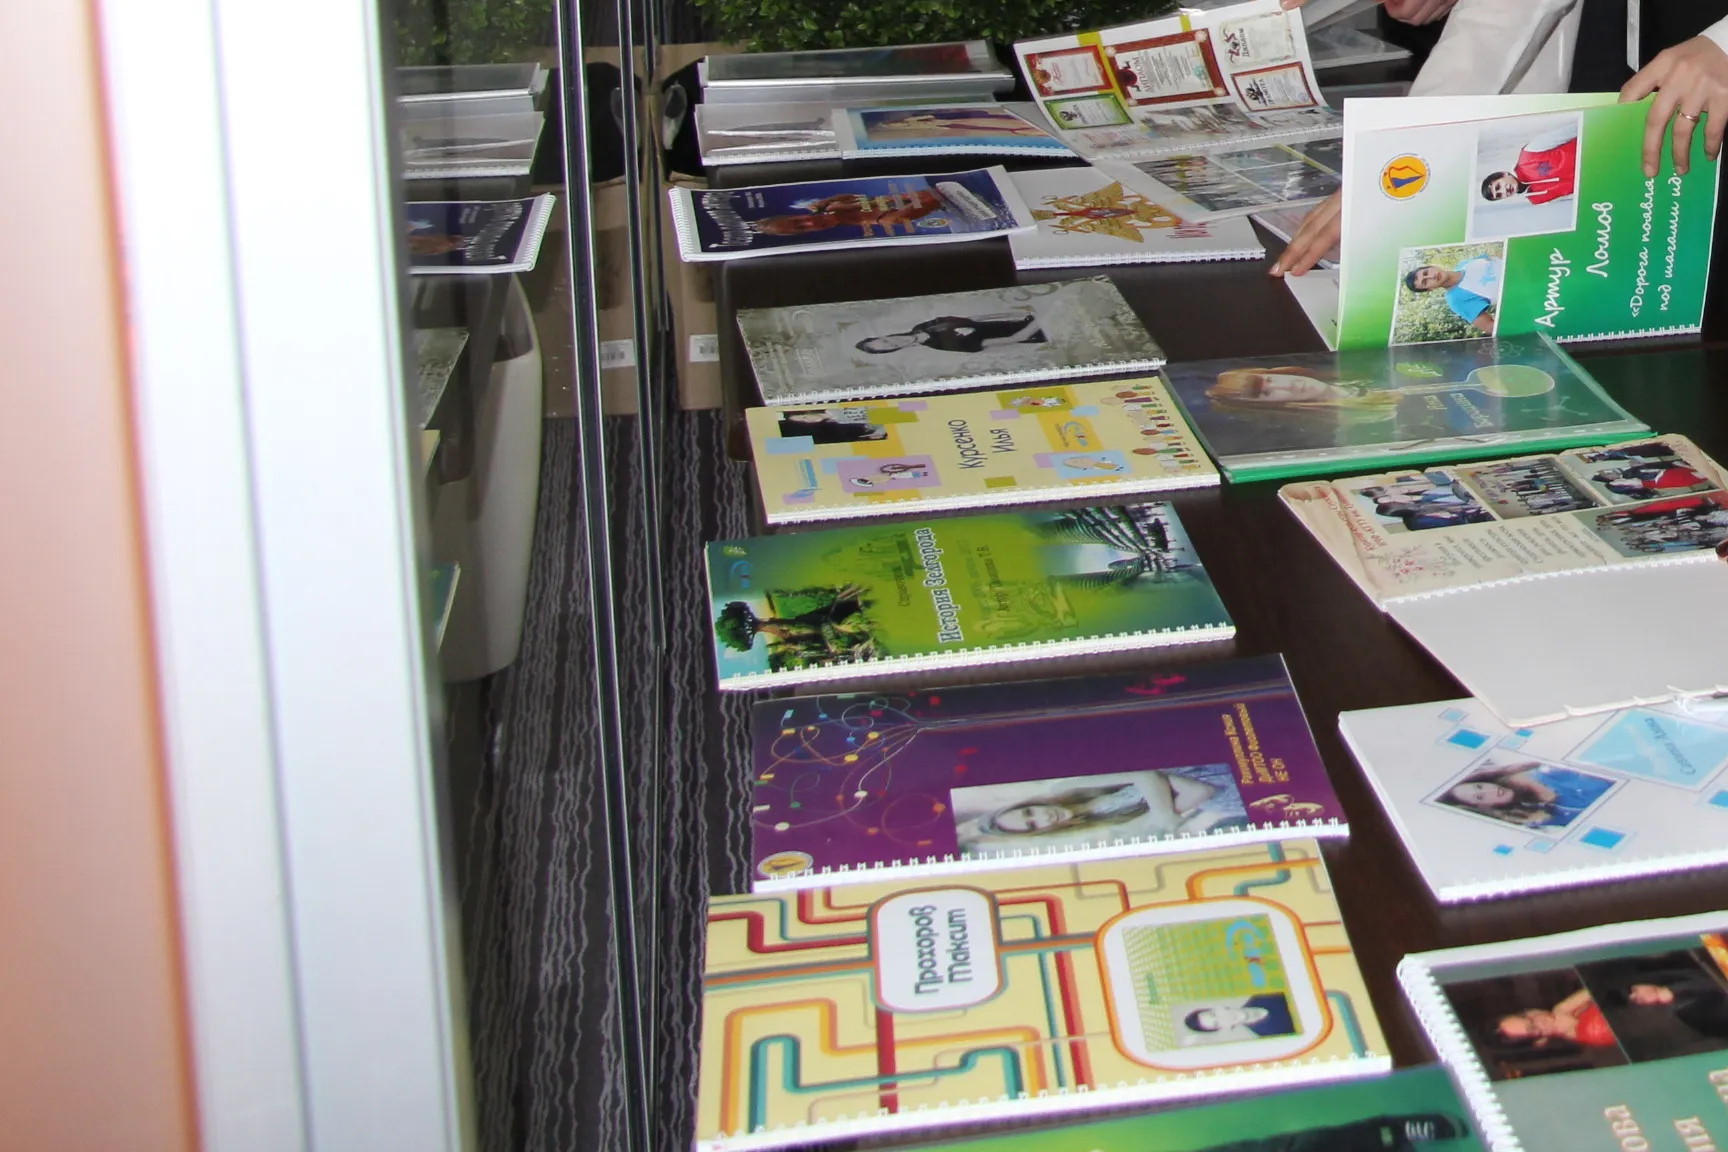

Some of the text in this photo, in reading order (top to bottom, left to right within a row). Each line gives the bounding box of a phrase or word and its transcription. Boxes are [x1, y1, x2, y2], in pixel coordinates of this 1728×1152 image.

[1586, 201, 1613, 278] Ломов
[1629, 177, 1655, 318] «Дорога появля
[1664, 201, 1681, 279] шагами
[1534, 248, 1571, 328] Артур
[1657, 284, 1673, 311] под
[947, 418, 985, 471] Курсенко
[991, 427, 1017, 454] Илья
[913, 526, 965, 646] История Зелгорода
[908, 903, 944, 997] Прохоров
[946, 907, 974, 984] Максим
